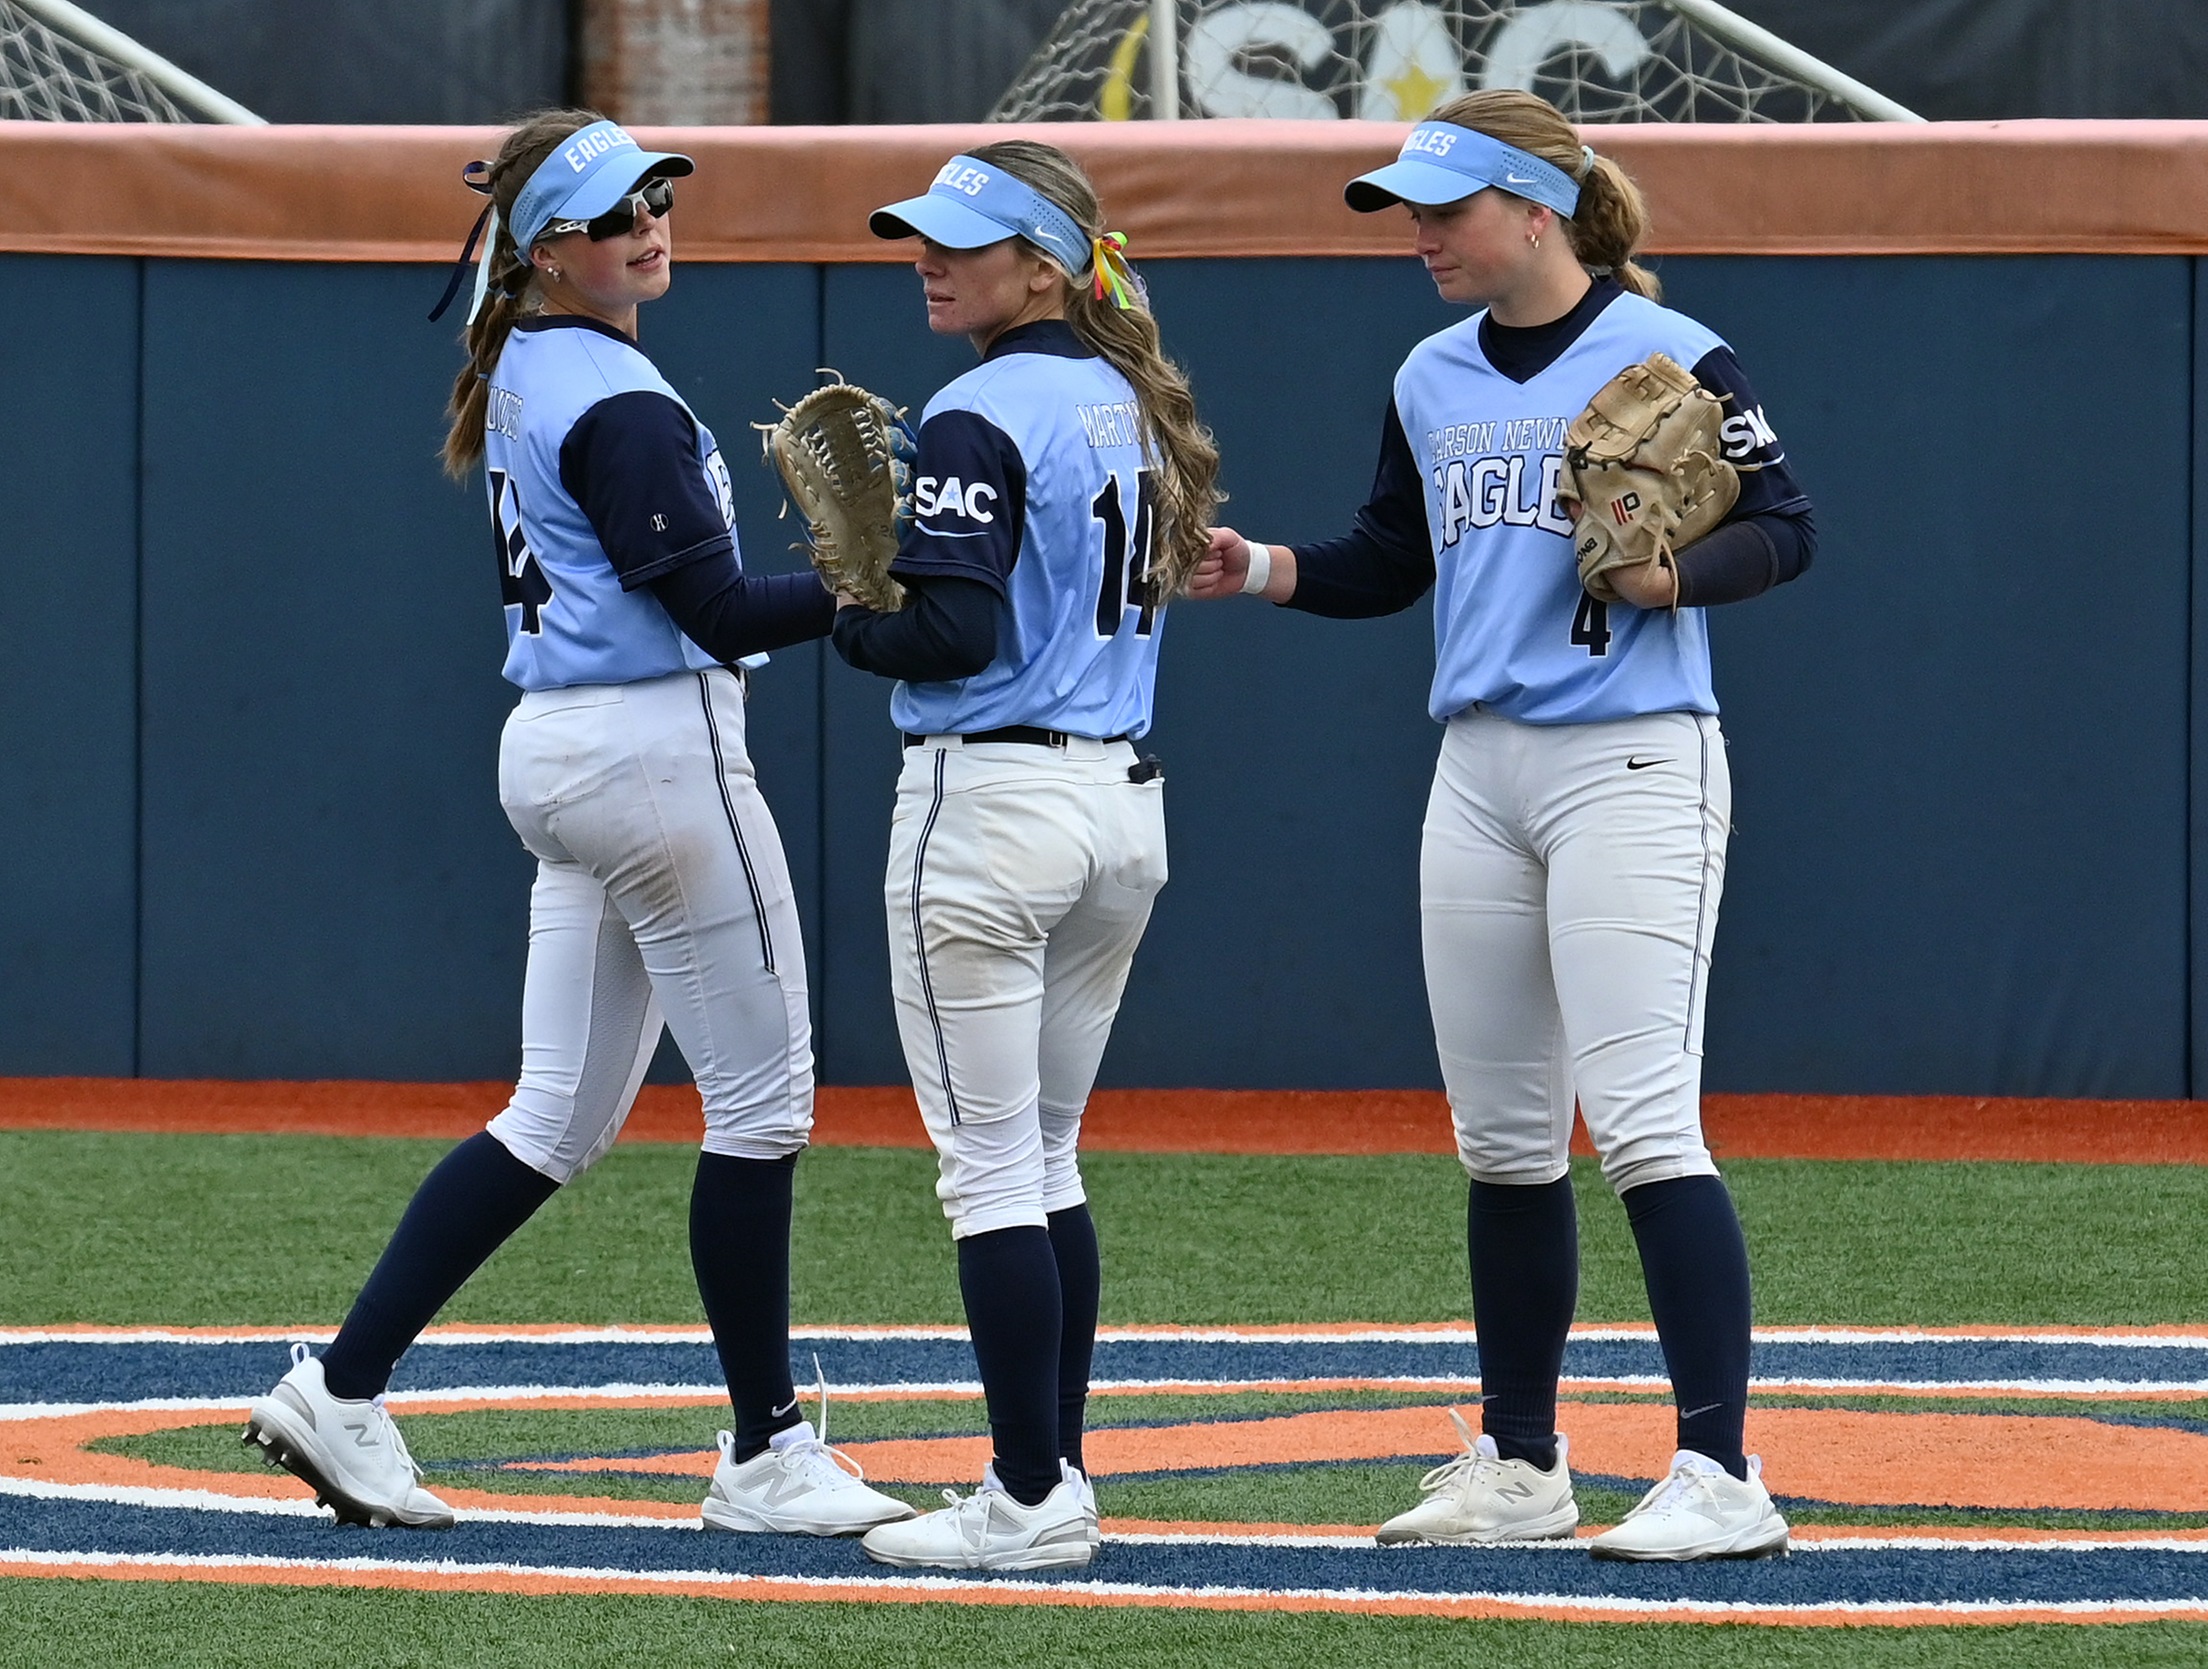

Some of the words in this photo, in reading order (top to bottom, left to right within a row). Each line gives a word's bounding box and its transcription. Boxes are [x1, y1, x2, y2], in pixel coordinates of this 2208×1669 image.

[915, 476, 998, 524] SAC
[1090, 467, 1164, 641] 14
[1569, 588, 1613, 659] 4
